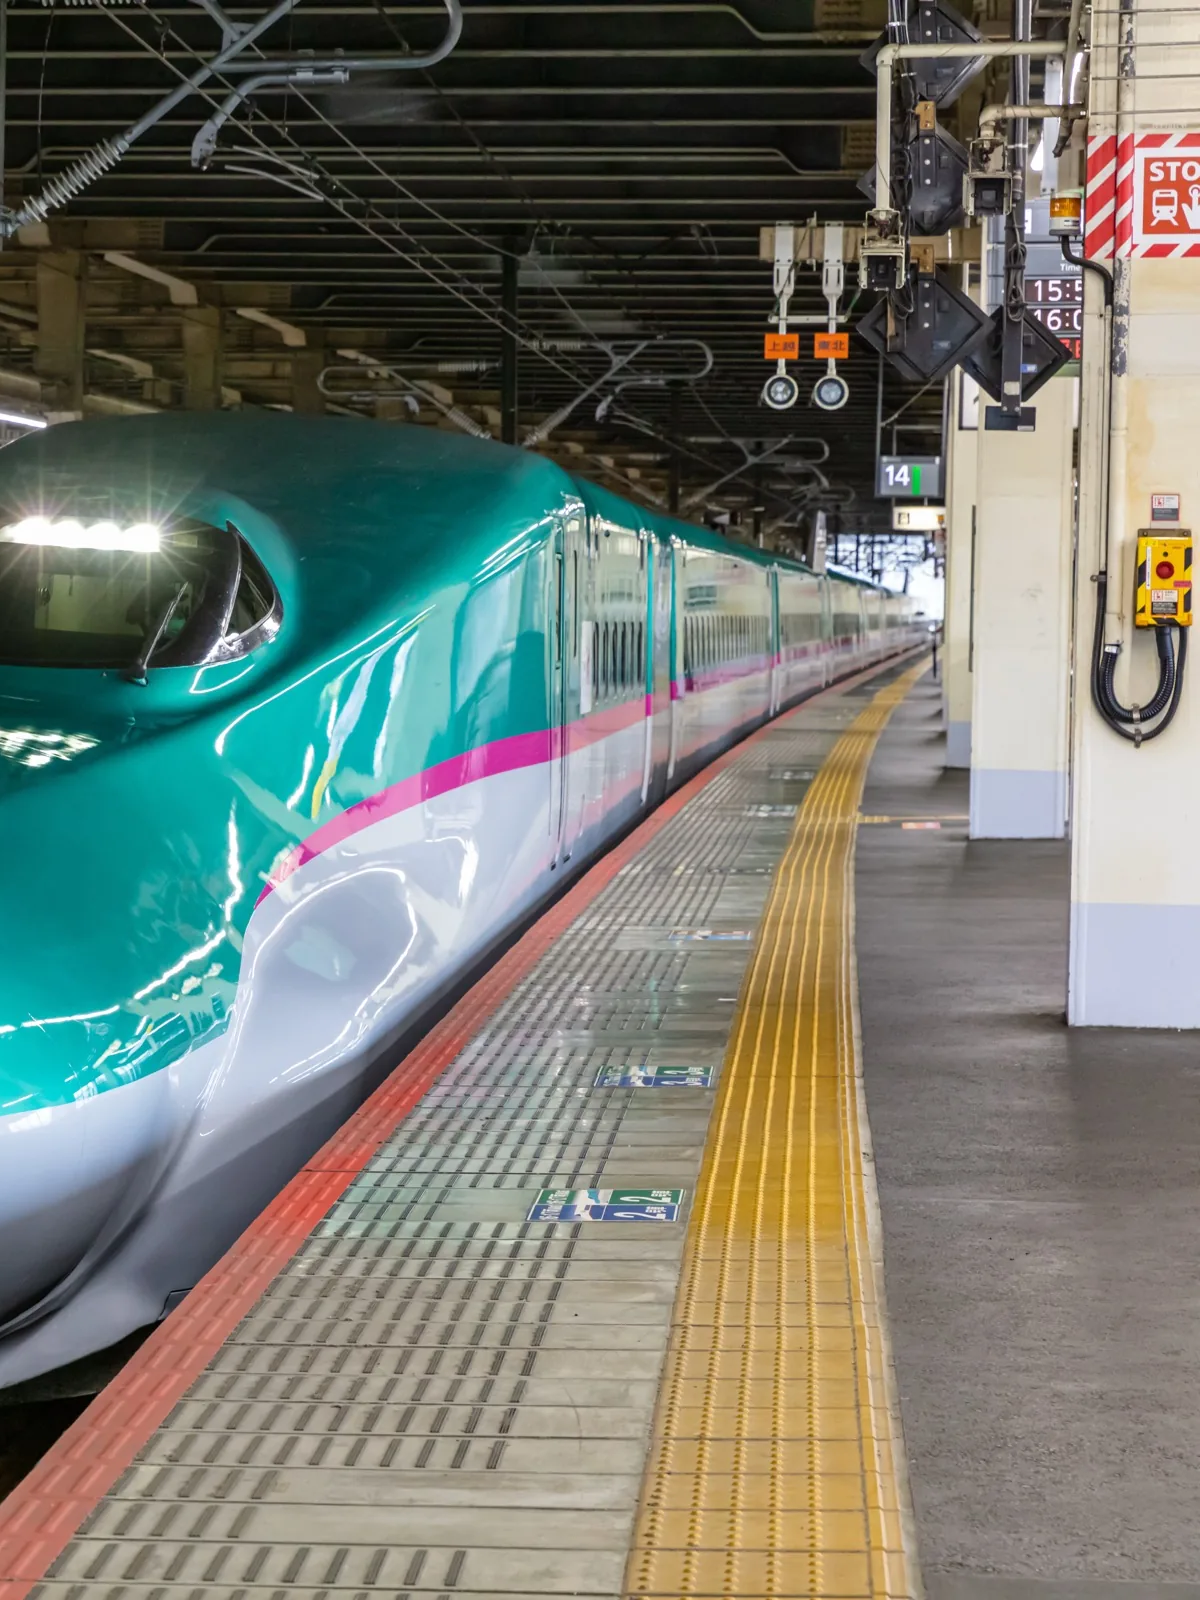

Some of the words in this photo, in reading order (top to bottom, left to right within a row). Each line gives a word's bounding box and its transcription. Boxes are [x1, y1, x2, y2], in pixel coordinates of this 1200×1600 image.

[767, 340, 796, 352] 上越
[818, 340, 846, 352] 東北
[885, 464, 911, 487] 14
